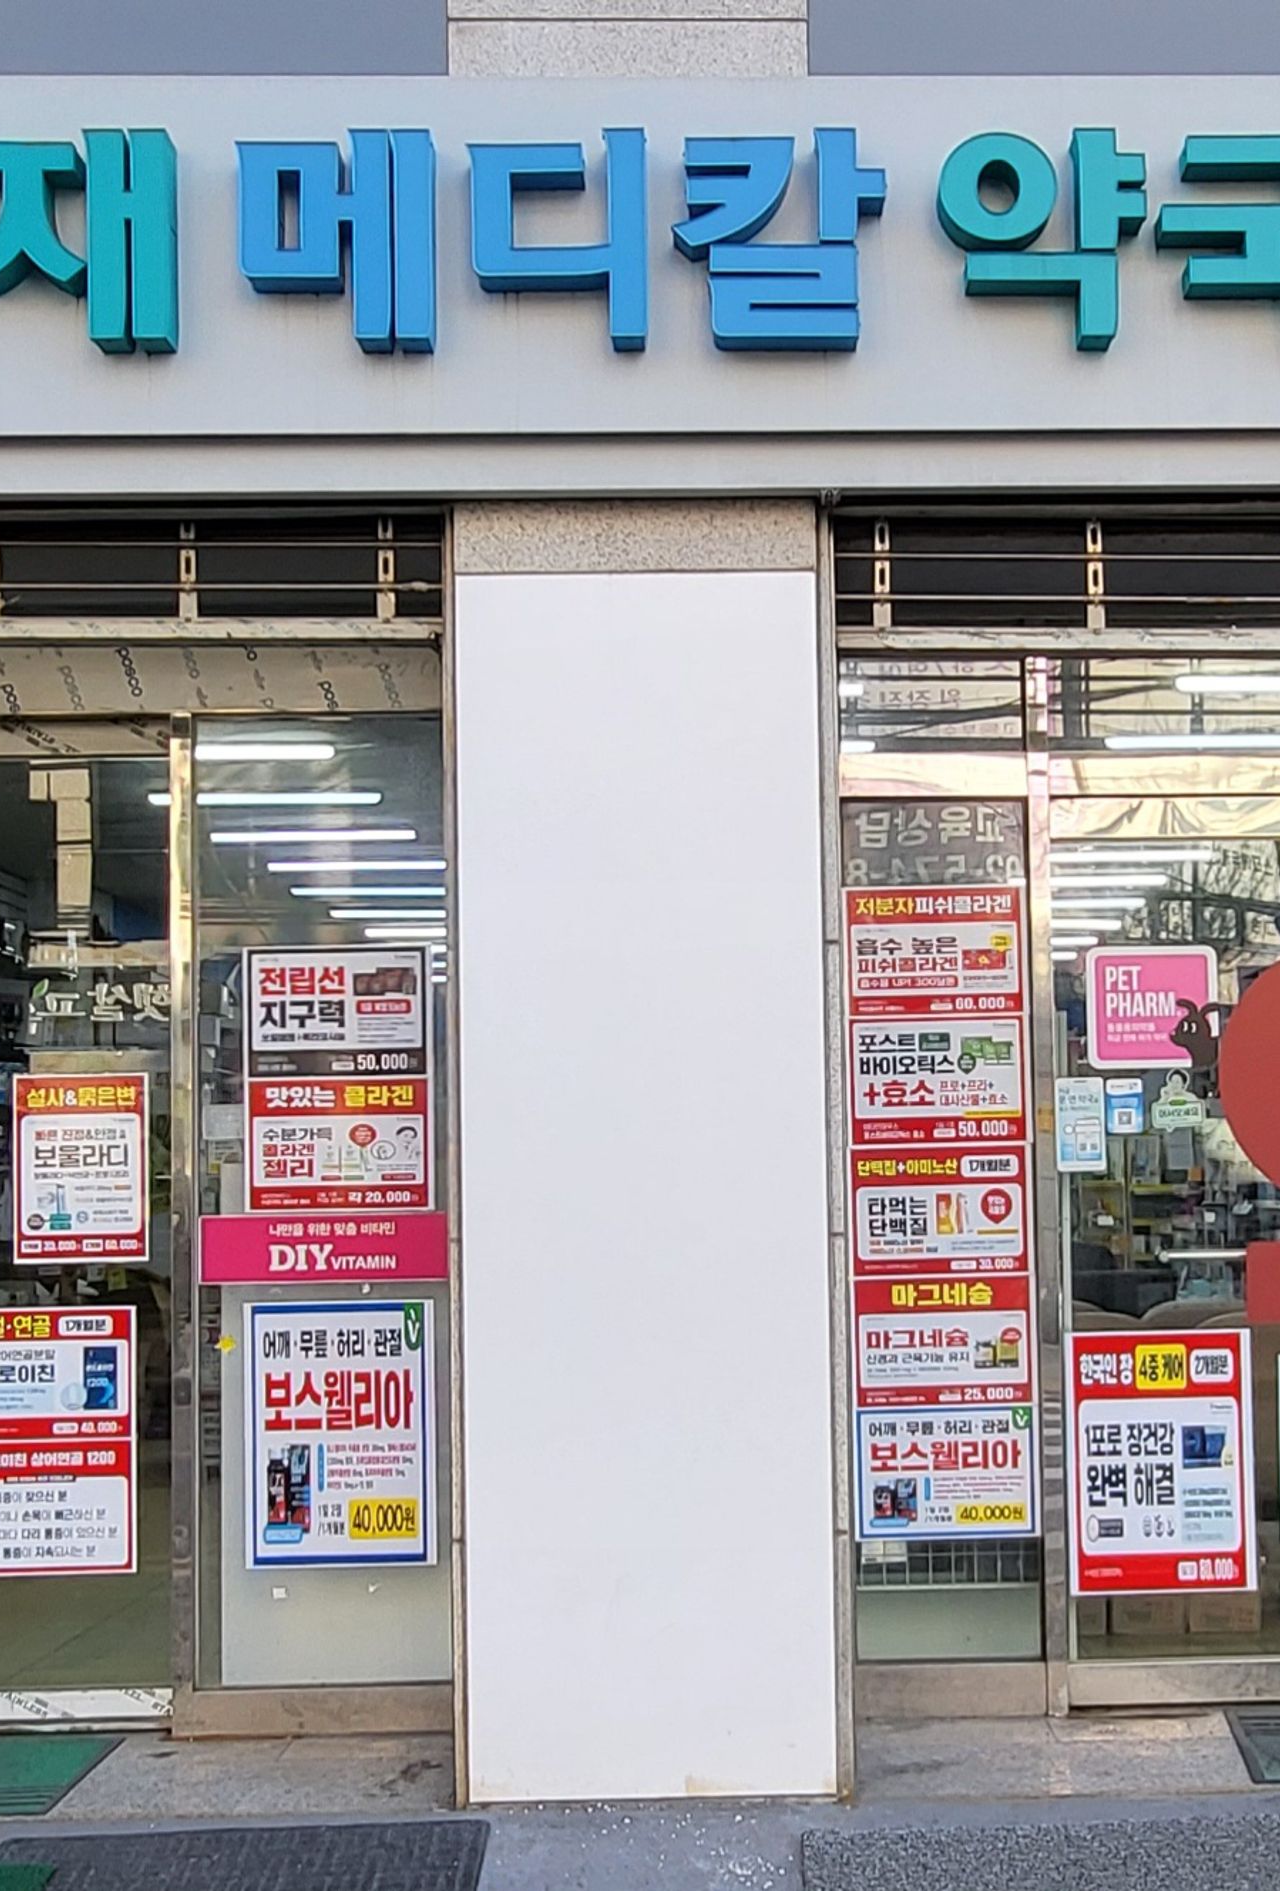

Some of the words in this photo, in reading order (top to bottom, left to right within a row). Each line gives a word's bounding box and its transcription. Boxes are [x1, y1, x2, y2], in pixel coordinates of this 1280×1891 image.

[235, 127, 888, 355] 메디칼
[856, 938, 902, 956] 흡수
[912, 936, 958, 955] 높은
[857, 957, 958, 973] 피쉬콜라겐
[259, 966, 345, 995] 전립선
[1104, 966, 1141, 991] PET
[260, 999, 345, 1029] 지구력
[859, 1034, 916, 1053] 포스트
[859, 1055, 955, 1075] 바이오틱스
[265, 1086, 335, 1108] 맛있는
[344, 1085, 414, 1106] 콜라겐
[863, 1080, 935, 1107] +효소
[262, 1127, 332, 1141] 수분가득
[34, 1143, 129, 1168] 보울라디
[262, 1144, 315, 1157] 콜라겐
[263, 1159, 313, 1178] 젤리
[868, 1196, 927, 1216] 타먹는
[269, 1223, 304, 1237] 나만을
[308, 1223, 330, 1236] 위한
[360, 1221, 395, 1235] 비타민
[869, 1217, 928, 1237] 단백질
[268, 1244, 333, 1272] DIY
[331, 1256, 396, 1270] VITAMIN
[891, 1282, 993, 1306] 마그네슘
[263, 1331, 291, 1360] 어깨
[300, 1329, 328, 1359] 무릎
[336, 1328, 365, 1358] 허리
[374, 1328, 403, 1357] 관절
[866, 1329, 968, 1349] 마그네슘
[1080, 1353, 1117, 1386] 한국인
[1120, 1353, 1133, 1385] 장
[1139, 1354, 1159, 1382] 4중
[1161, 1353, 1183, 1381] 케어
[264, 1368, 414, 1431] 보스웰리아
[869, 1422, 897, 1436] 어깨
[944, 1420, 972, 1434] 허리
[982, 1419, 1009, 1433] 관절
[1085, 1423, 1122, 1456] 1포로
[1126, 1422, 1174, 1456] 장건강
[870, 1439, 1021, 1472] 보스웰리아
[1086, 1463, 1127, 1507] 완벽
[1134, 1463, 1175, 1506] 해결
